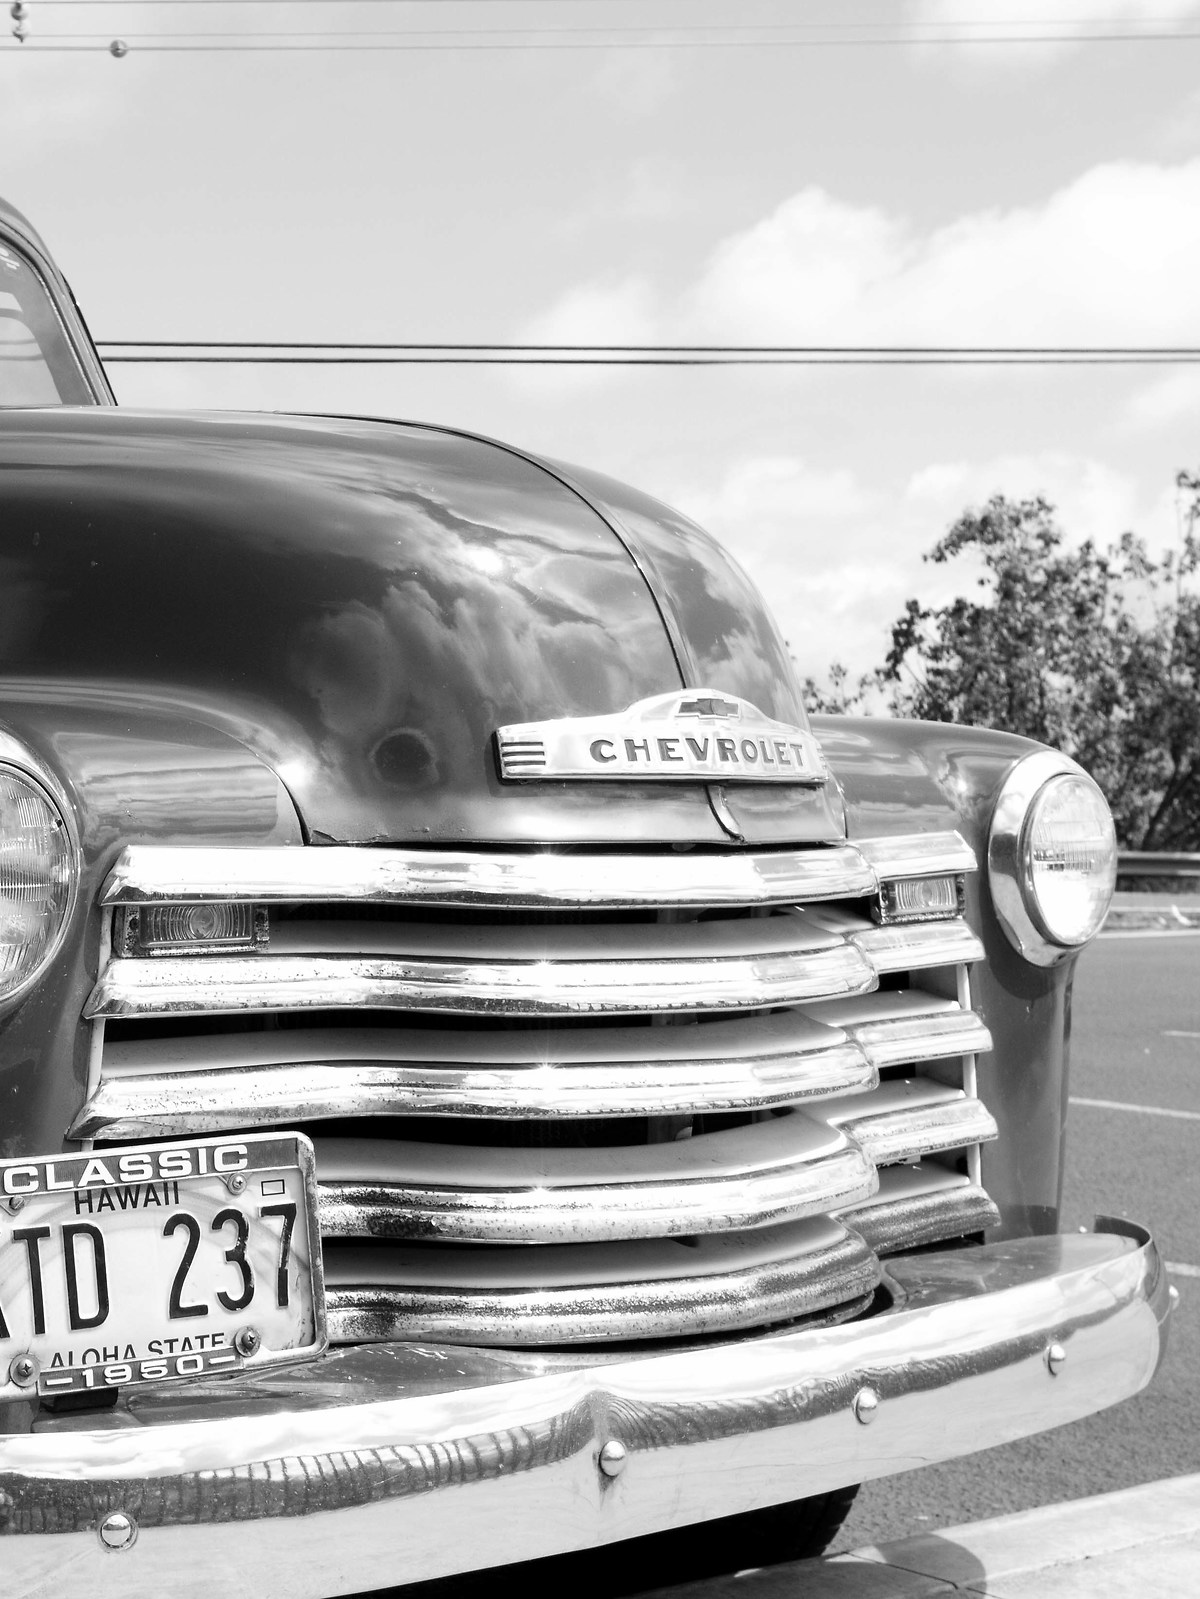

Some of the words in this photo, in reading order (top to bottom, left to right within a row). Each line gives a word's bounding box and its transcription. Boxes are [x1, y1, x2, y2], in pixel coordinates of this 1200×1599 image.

[589, 738, 803, 767] CHEVROLET
[3, 1144, 248, 1195] CLASSIC
[74, 1181, 180, 1215] HAWAII
[162, 1202, 297, 1320] 237
